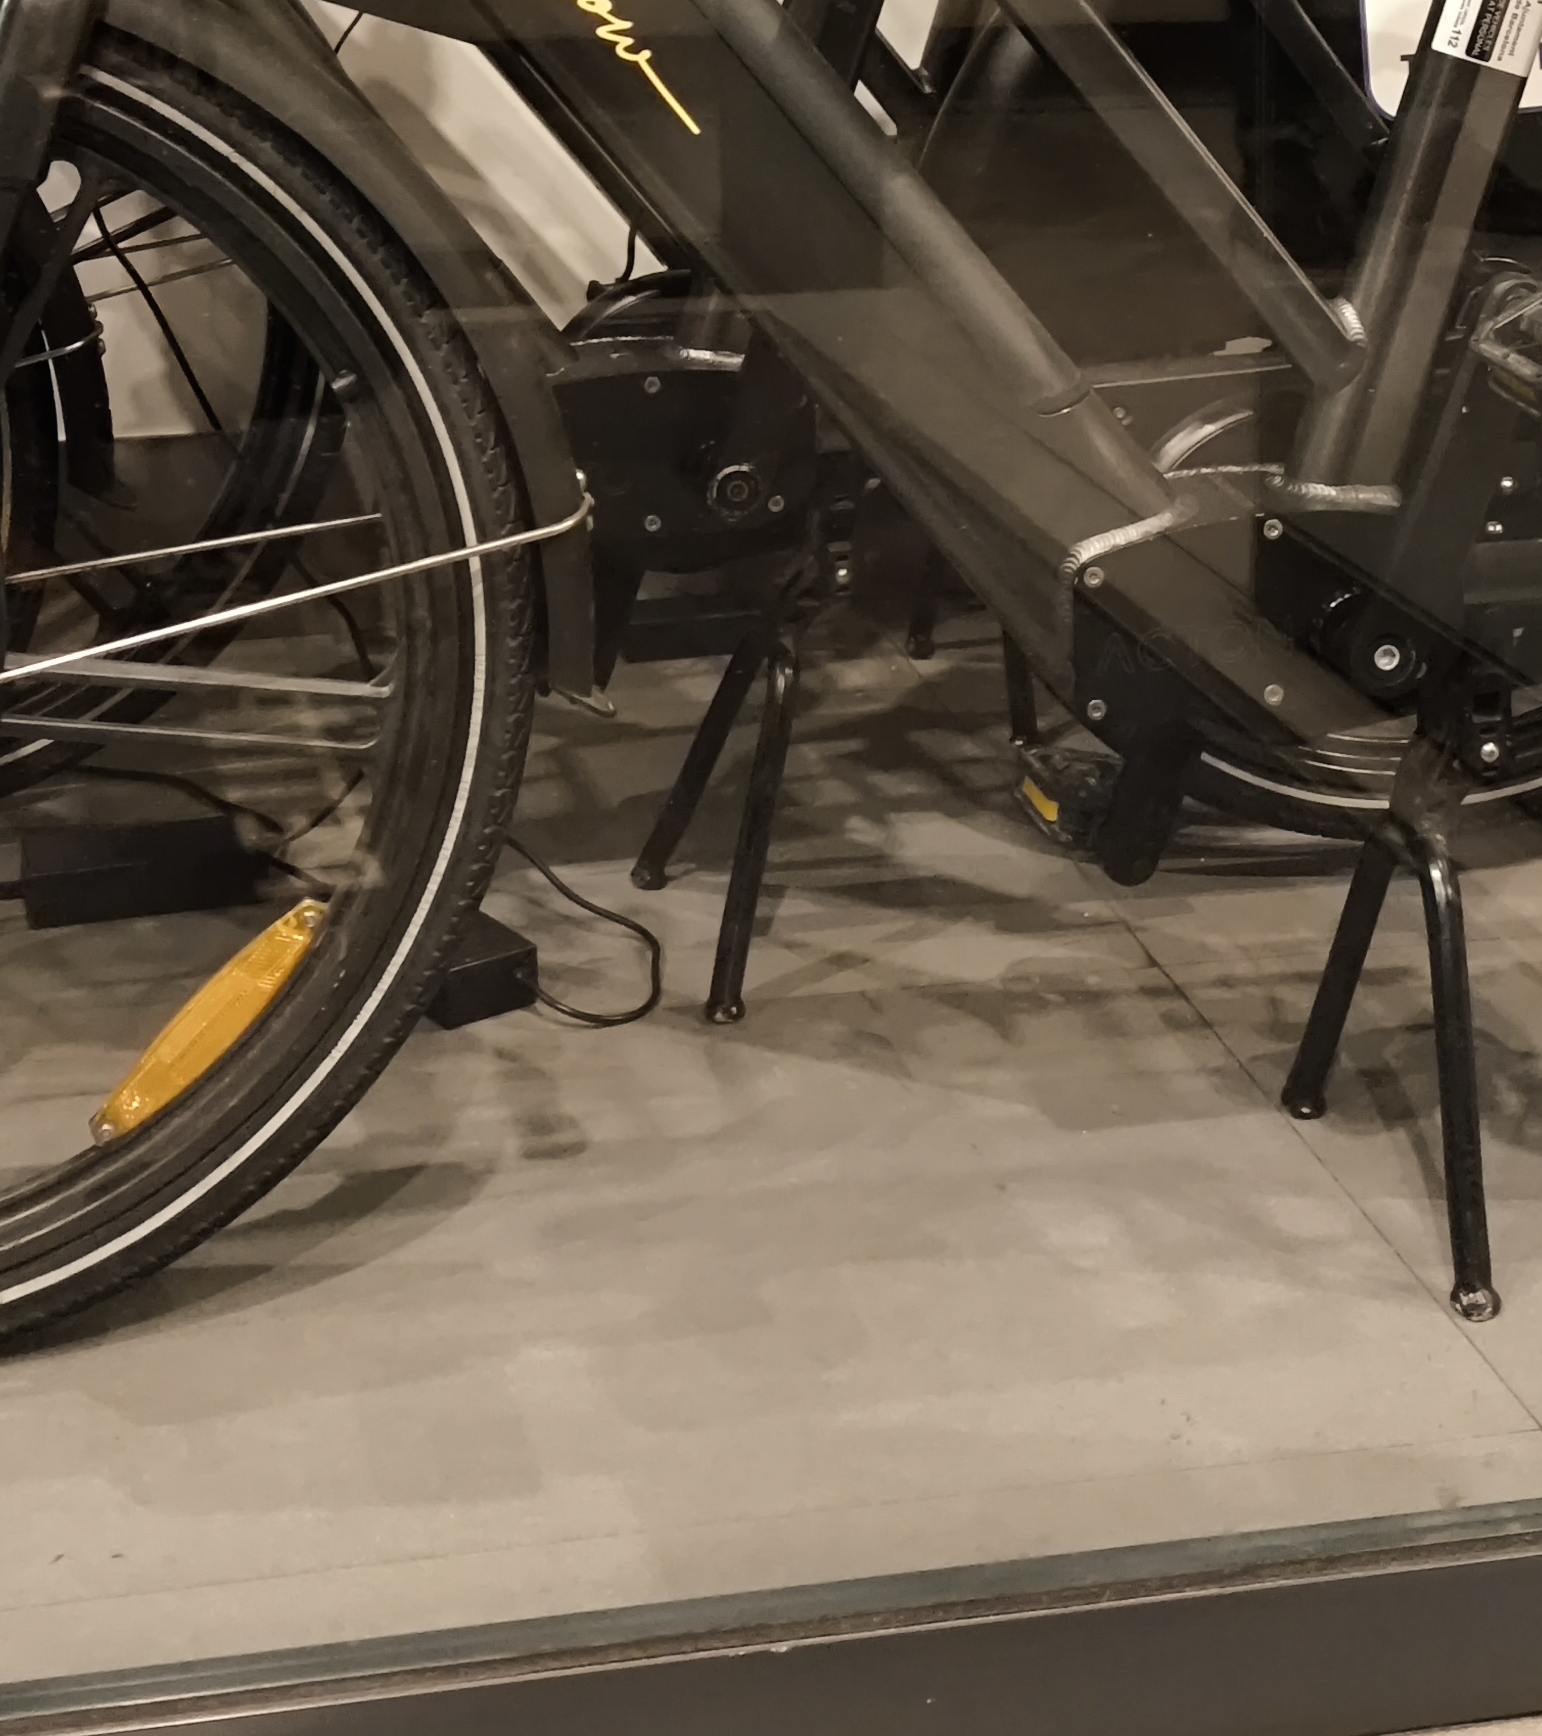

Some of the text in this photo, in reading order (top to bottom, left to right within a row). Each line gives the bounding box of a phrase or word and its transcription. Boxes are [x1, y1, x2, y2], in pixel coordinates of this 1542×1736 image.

[1446, 27, 1462, 48] 112
[1471, 12, 1492, 57] PERSONAL
[1496, 11, 1518, 62] Barcelona
[1507, 0, 1532, 57] Ajuntament
